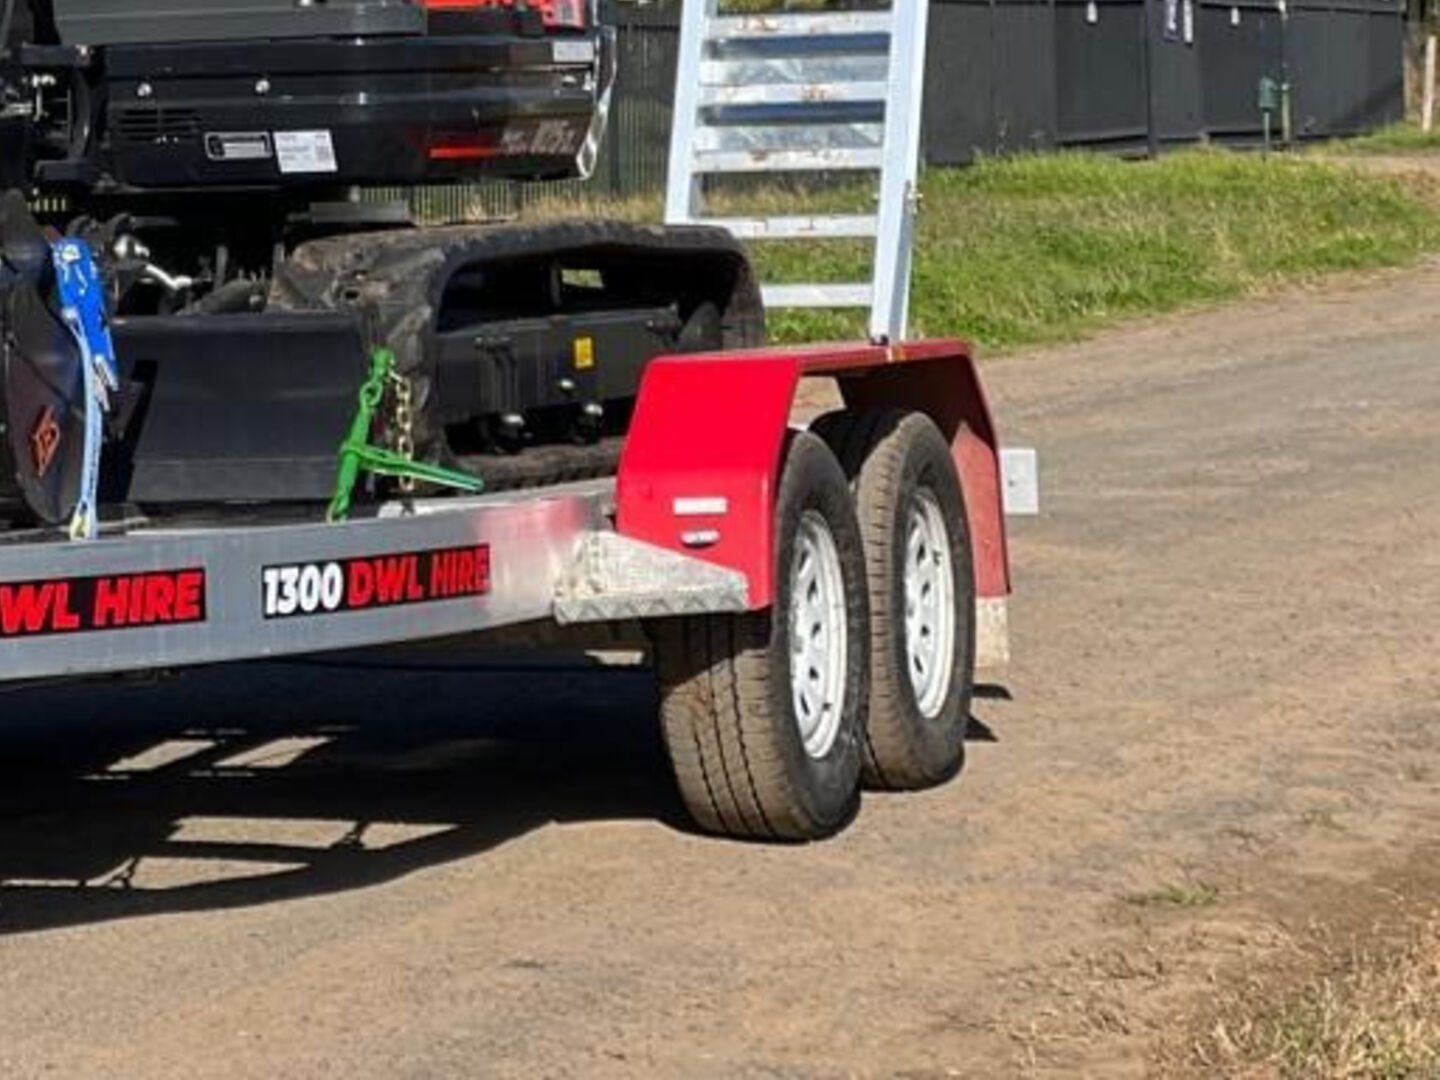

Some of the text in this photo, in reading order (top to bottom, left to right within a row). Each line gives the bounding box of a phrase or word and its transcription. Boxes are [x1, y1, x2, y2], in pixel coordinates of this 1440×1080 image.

[92, 572, 203, 626] HIRE
[264, 547, 490, 614] 1300 DWL HIRE
